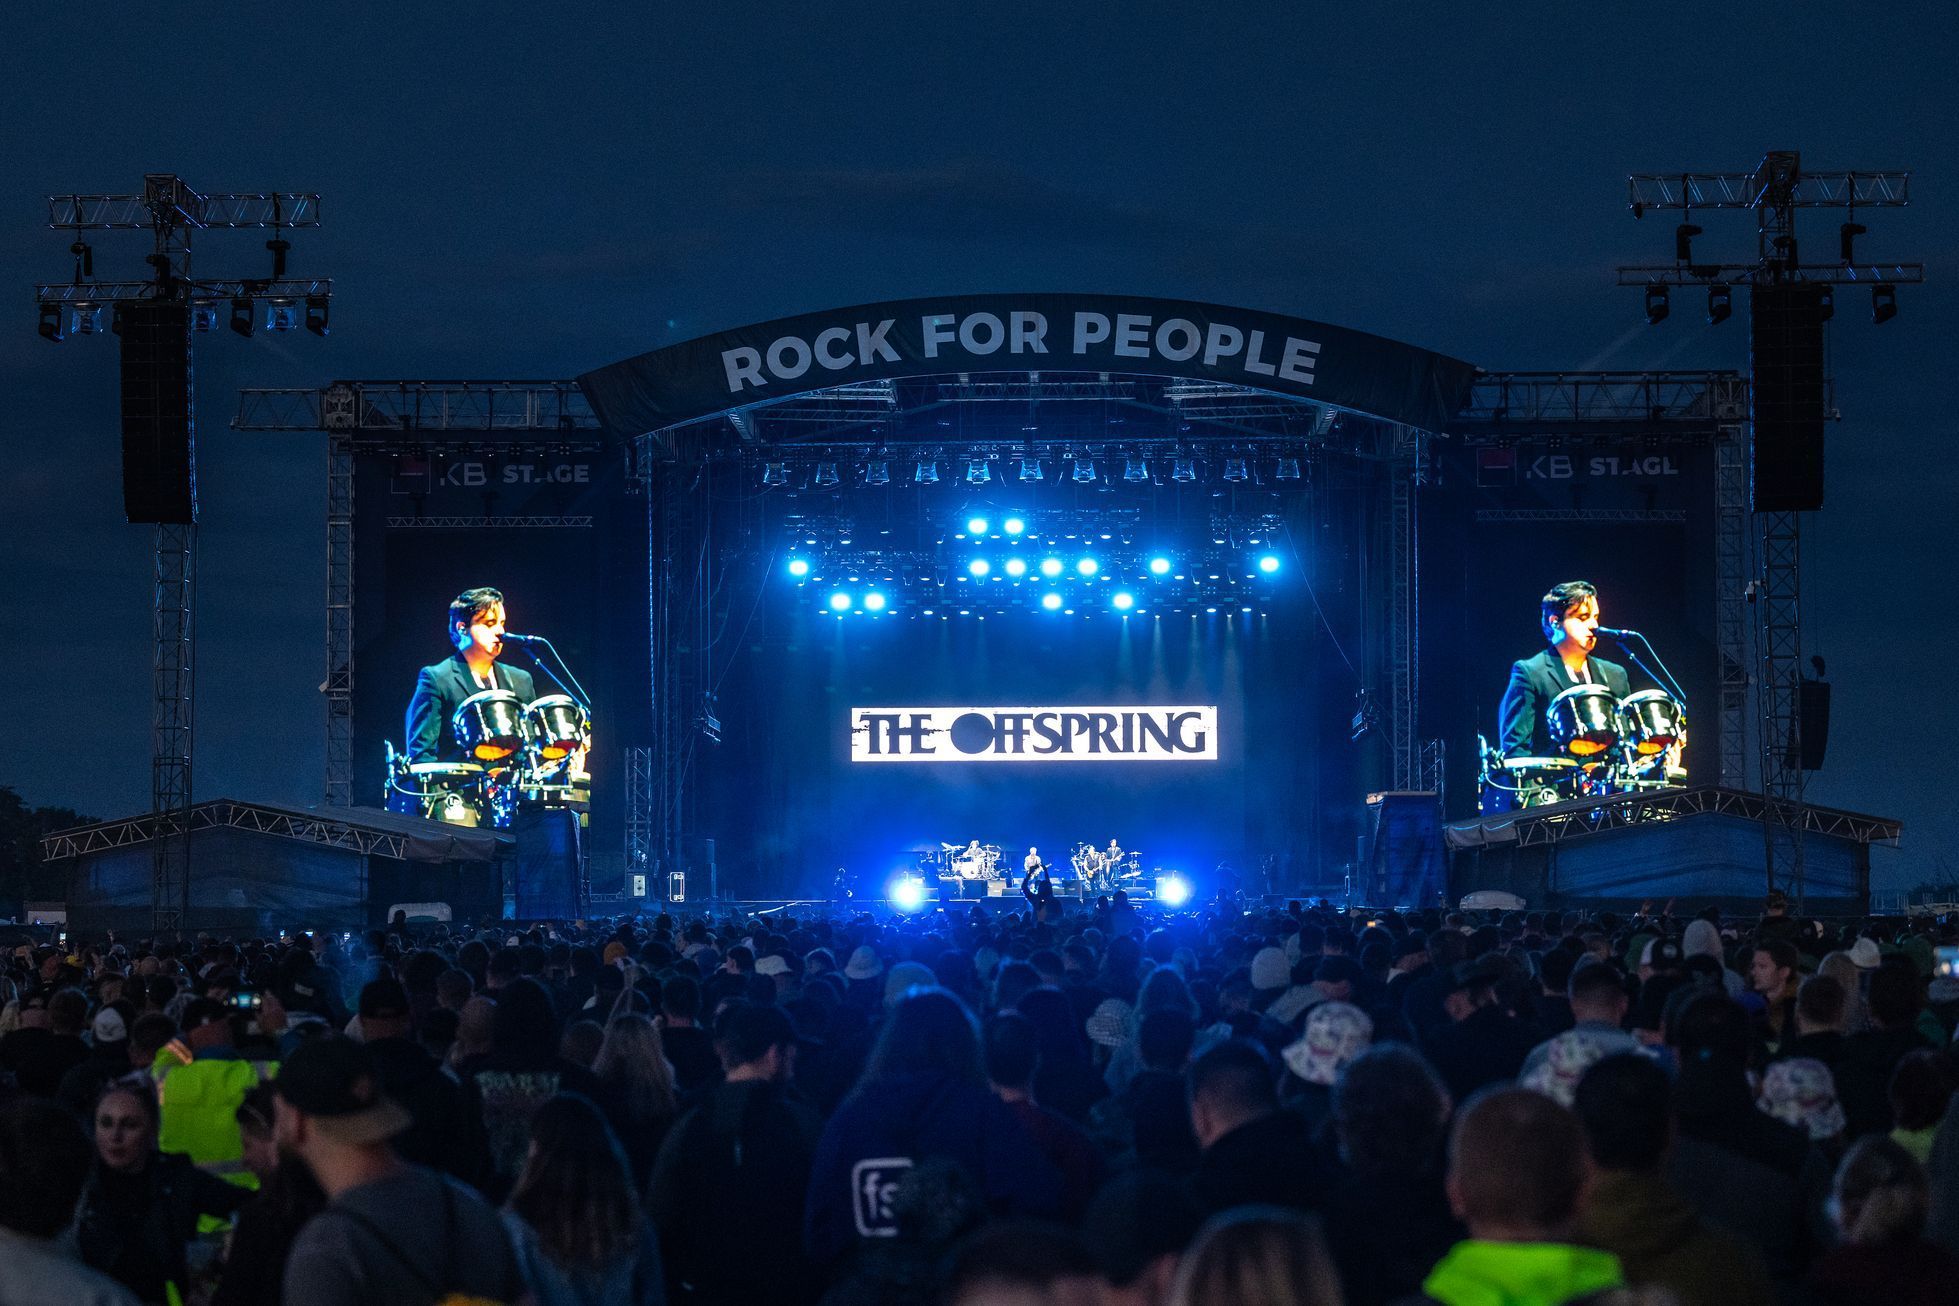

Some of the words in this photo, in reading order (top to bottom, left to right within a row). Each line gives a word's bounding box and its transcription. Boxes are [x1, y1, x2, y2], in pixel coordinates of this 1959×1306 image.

[721, 320, 901, 393] ROCK
[922, 312, 1049, 358] FOR
[1073, 313, 1322, 385] PEOPLE
[860, 714, 937, 754] THE
[950, 712, 1206, 755] OFFSPRING
